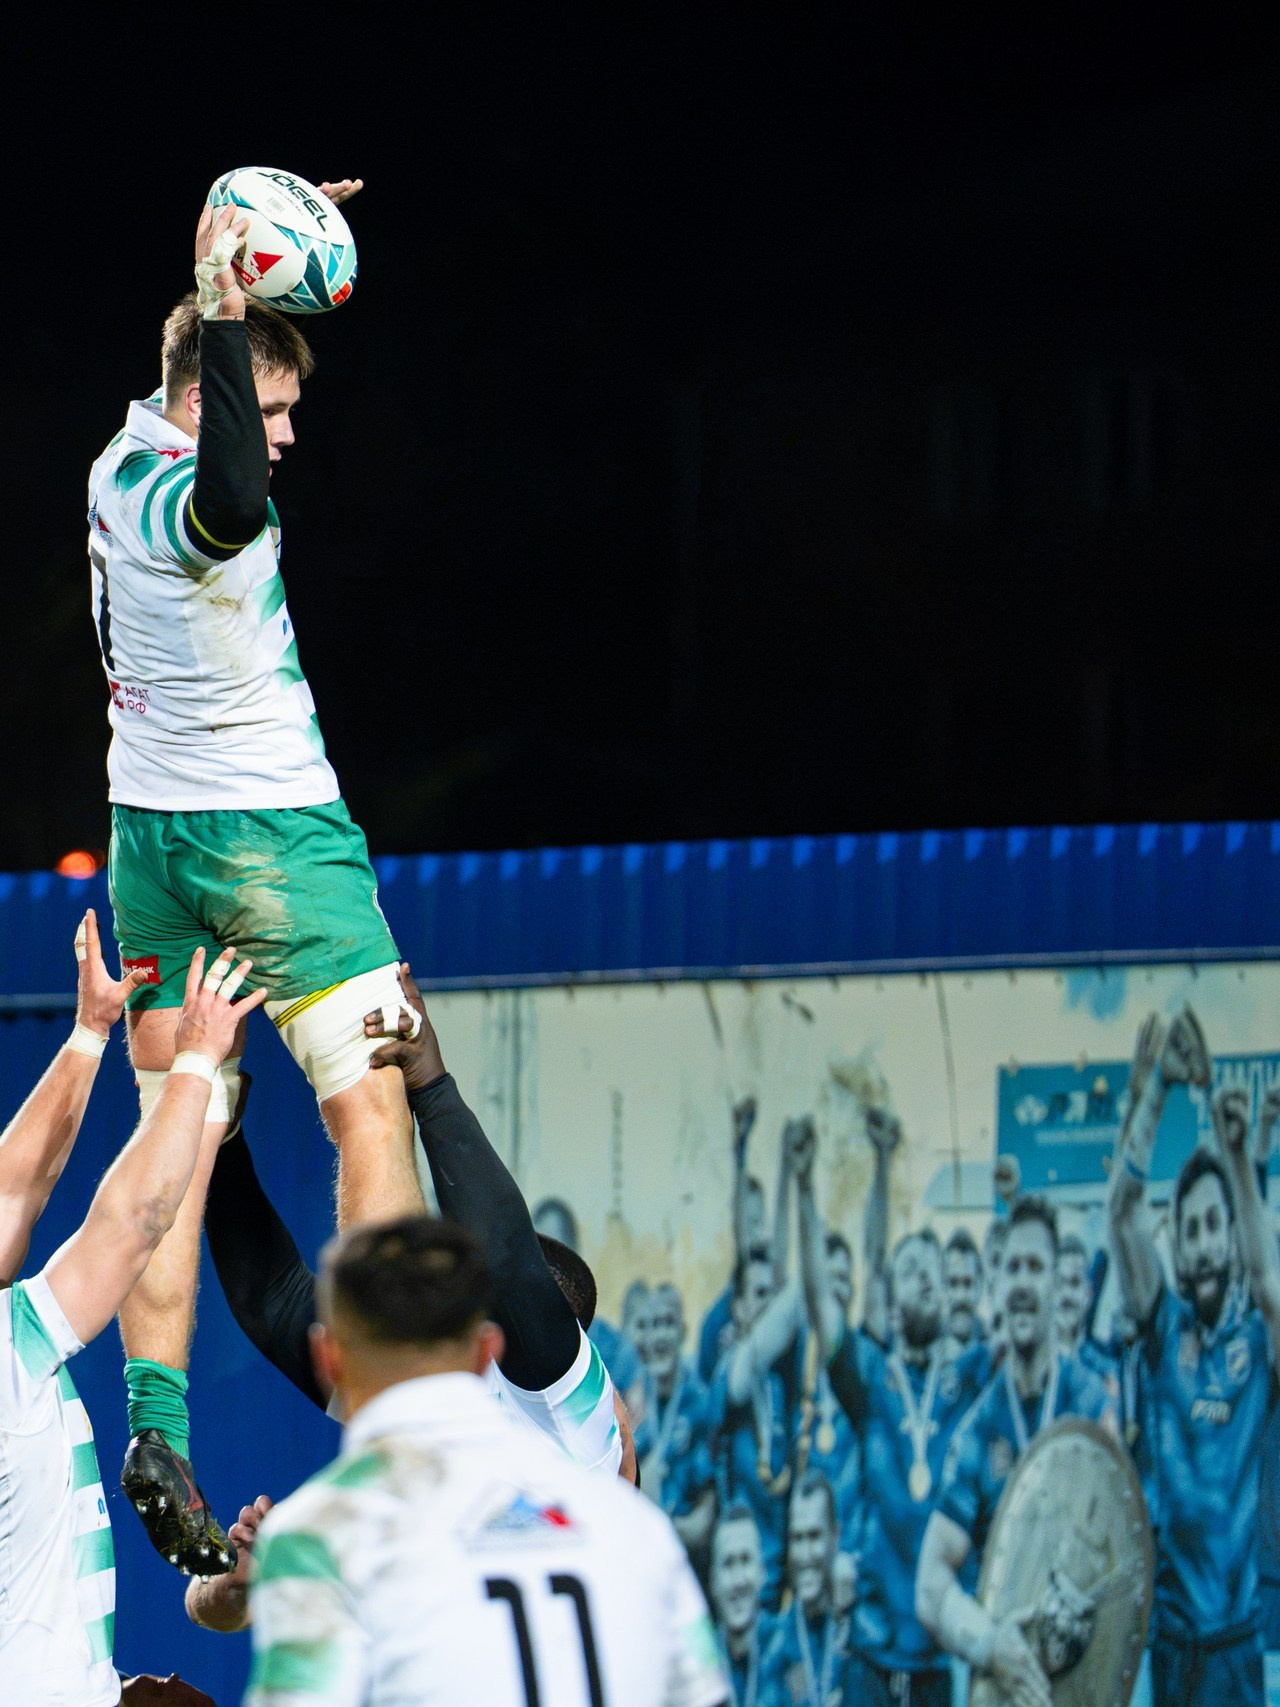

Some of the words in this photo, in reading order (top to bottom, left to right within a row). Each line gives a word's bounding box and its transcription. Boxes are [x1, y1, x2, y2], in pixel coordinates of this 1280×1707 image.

[256, 172, 328, 232] JÖGEL
[124, 685, 151, 701] АГАТ
[127, 699, 147, 714] РФ
[484, 1573, 605, 1707] 11
